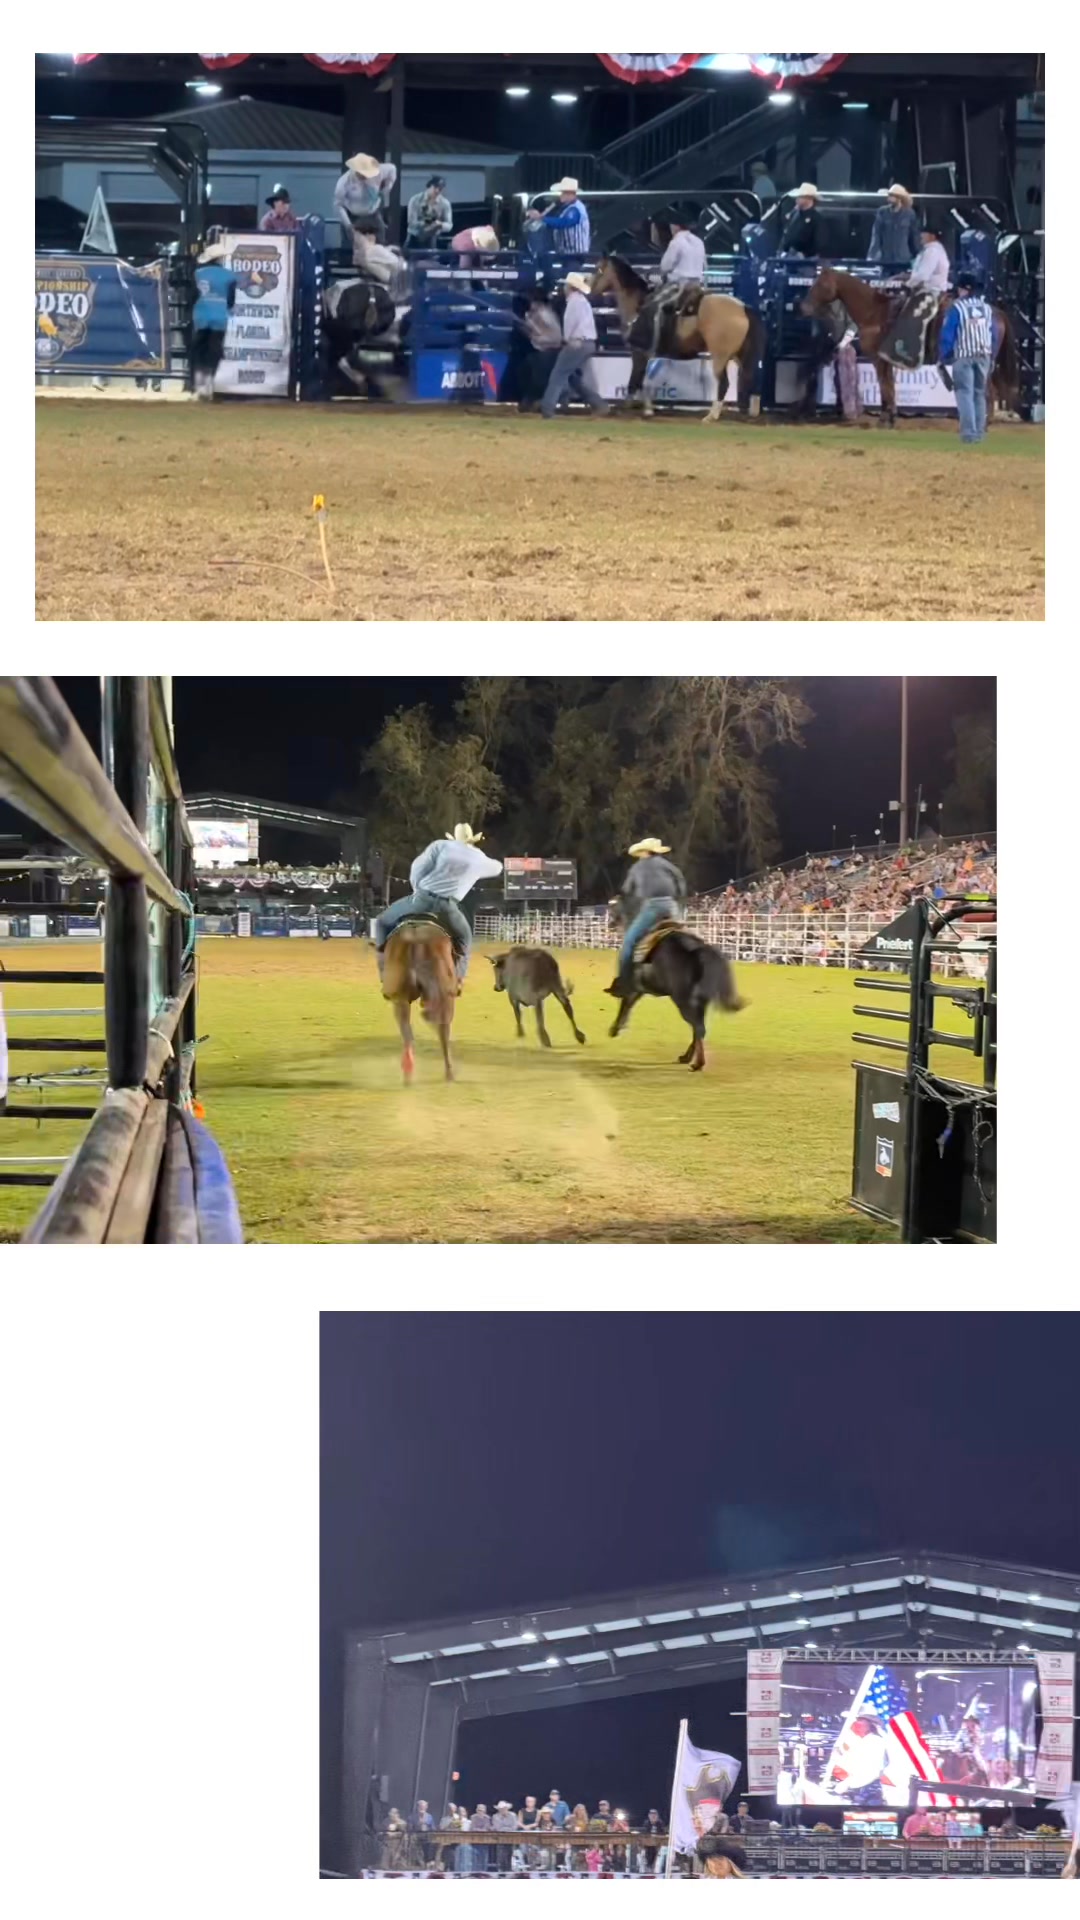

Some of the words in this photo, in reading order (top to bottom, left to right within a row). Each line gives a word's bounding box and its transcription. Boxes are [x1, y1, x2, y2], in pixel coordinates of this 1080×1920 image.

[233, 259, 281, 275] RODEO
[35, 281, 89, 292] PIONSHIP
[35, 292, 89, 318] DEO
[441, 371, 486, 389] ABBOTT
